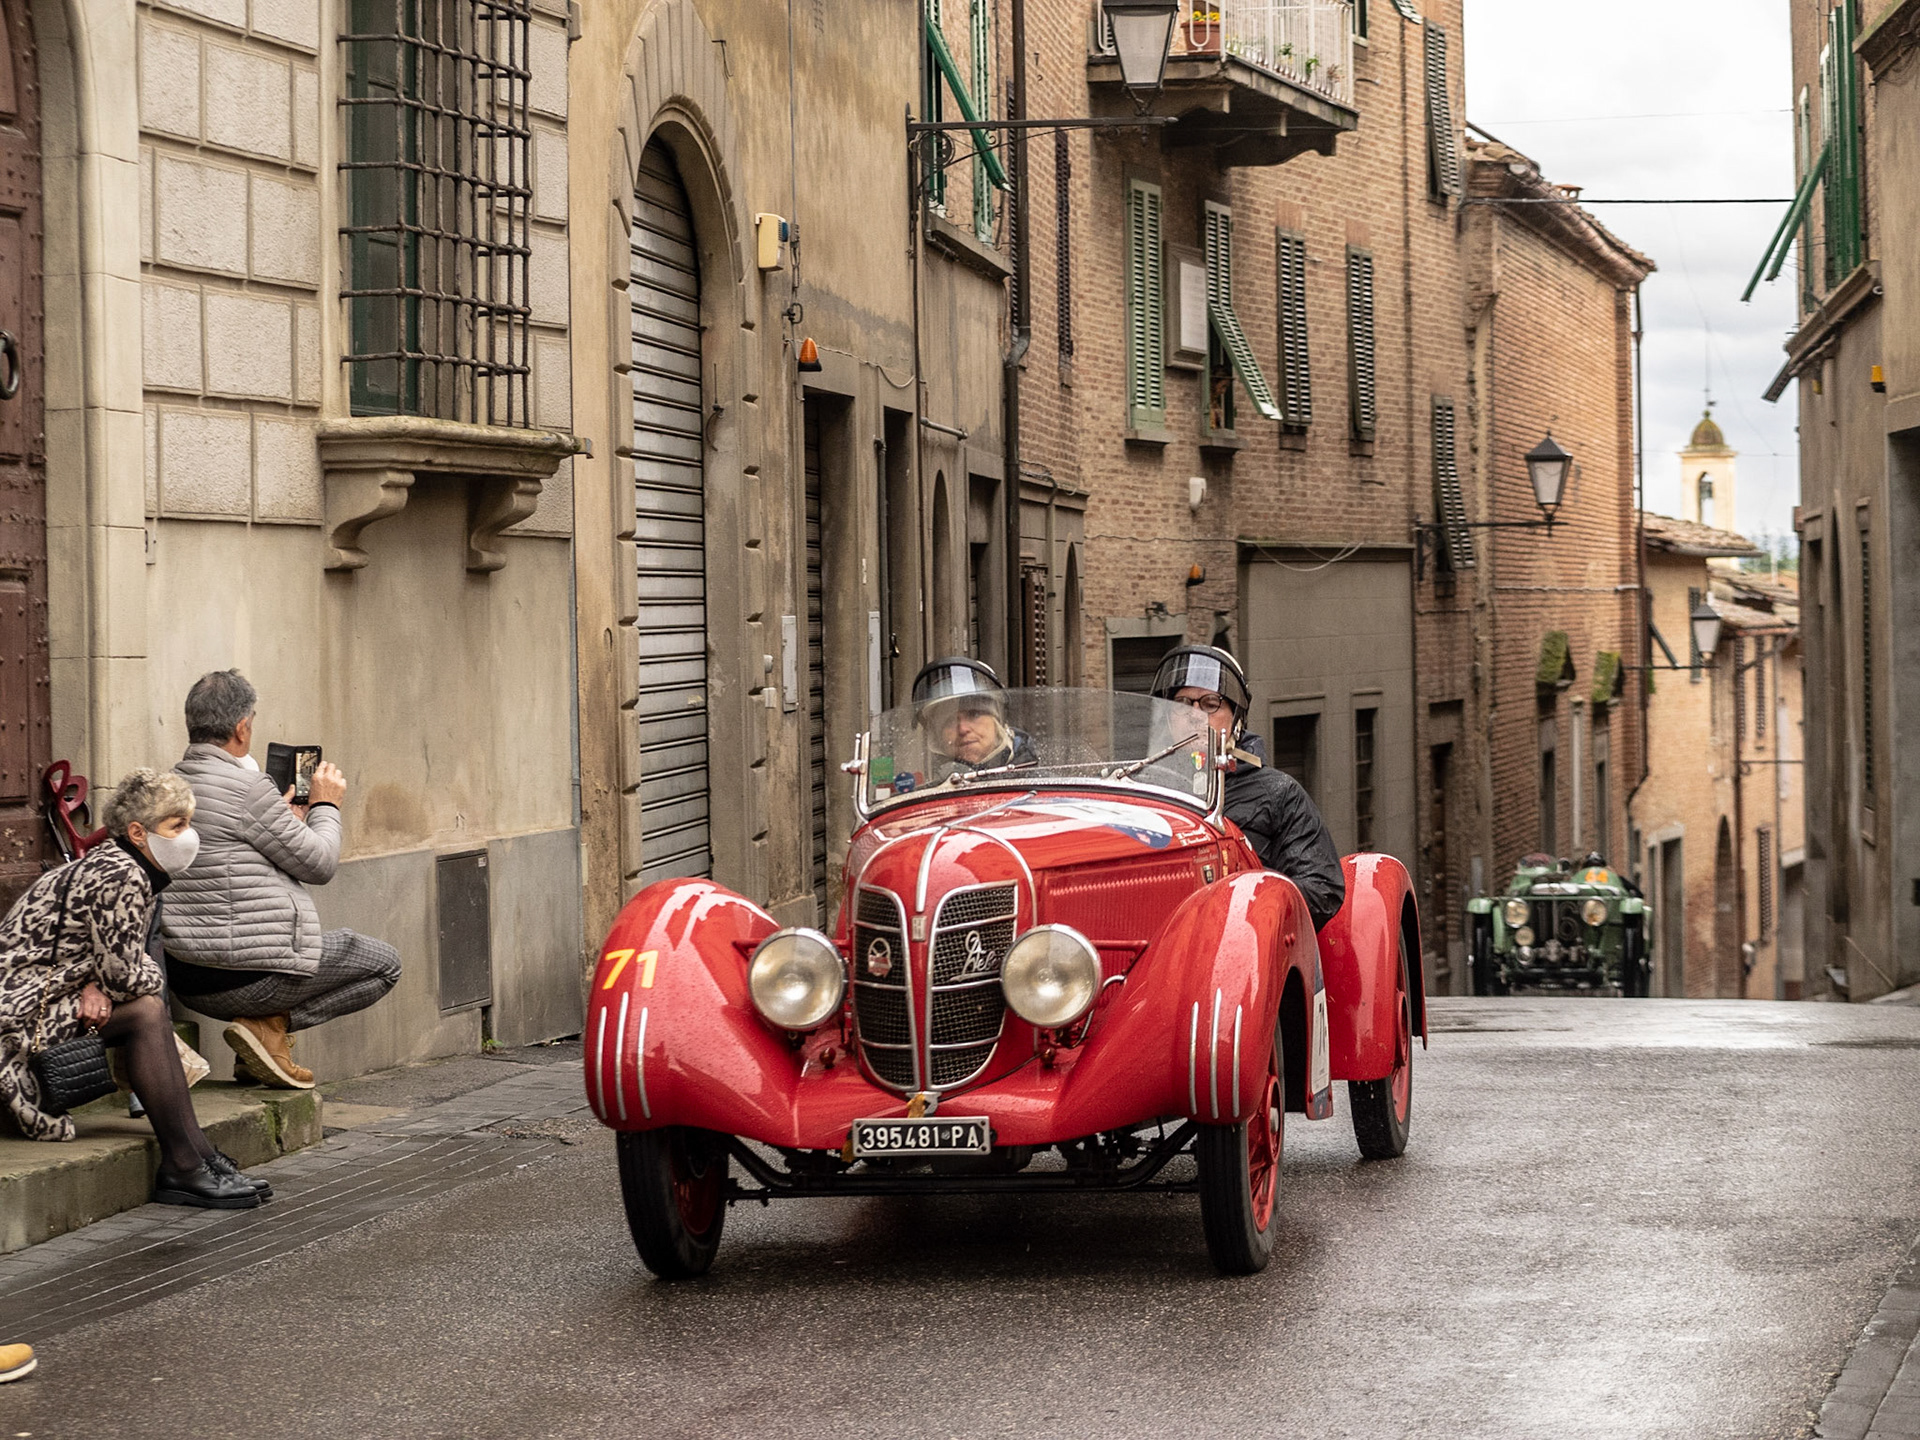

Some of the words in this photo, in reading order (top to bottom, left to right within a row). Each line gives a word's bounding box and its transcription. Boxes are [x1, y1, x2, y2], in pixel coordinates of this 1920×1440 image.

[602, 948, 659, 990] 71
[862, 1126, 940, 1149] 395481
[951, 1125, 979, 1148] PA
